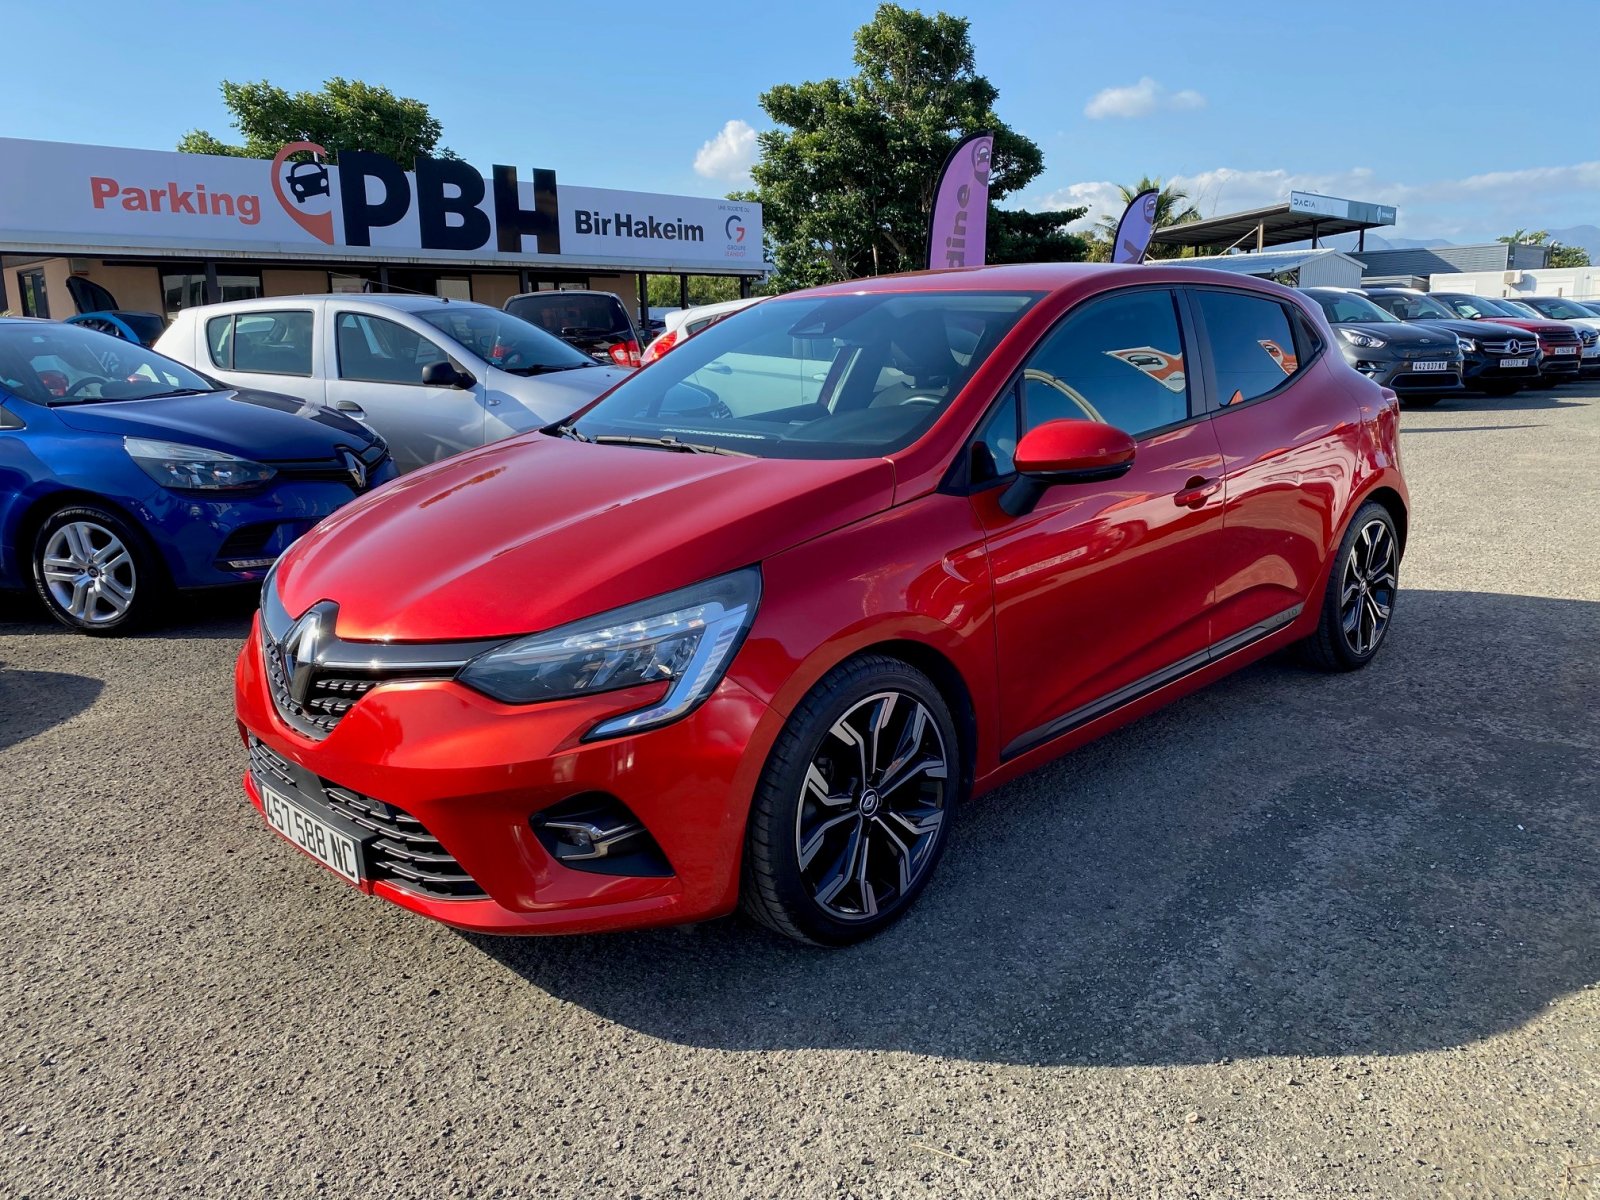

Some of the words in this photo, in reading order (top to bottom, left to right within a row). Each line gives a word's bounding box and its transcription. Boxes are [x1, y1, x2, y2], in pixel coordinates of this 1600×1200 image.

[89, 176, 261, 226] Parking
[337, 150, 561, 255] PBH
[1293, 198, 1316, 209] DACIA
[265, 792, 292, 838] 457
[293, 810, 328, 861] 588
[329, 832, 355, 878] NC
